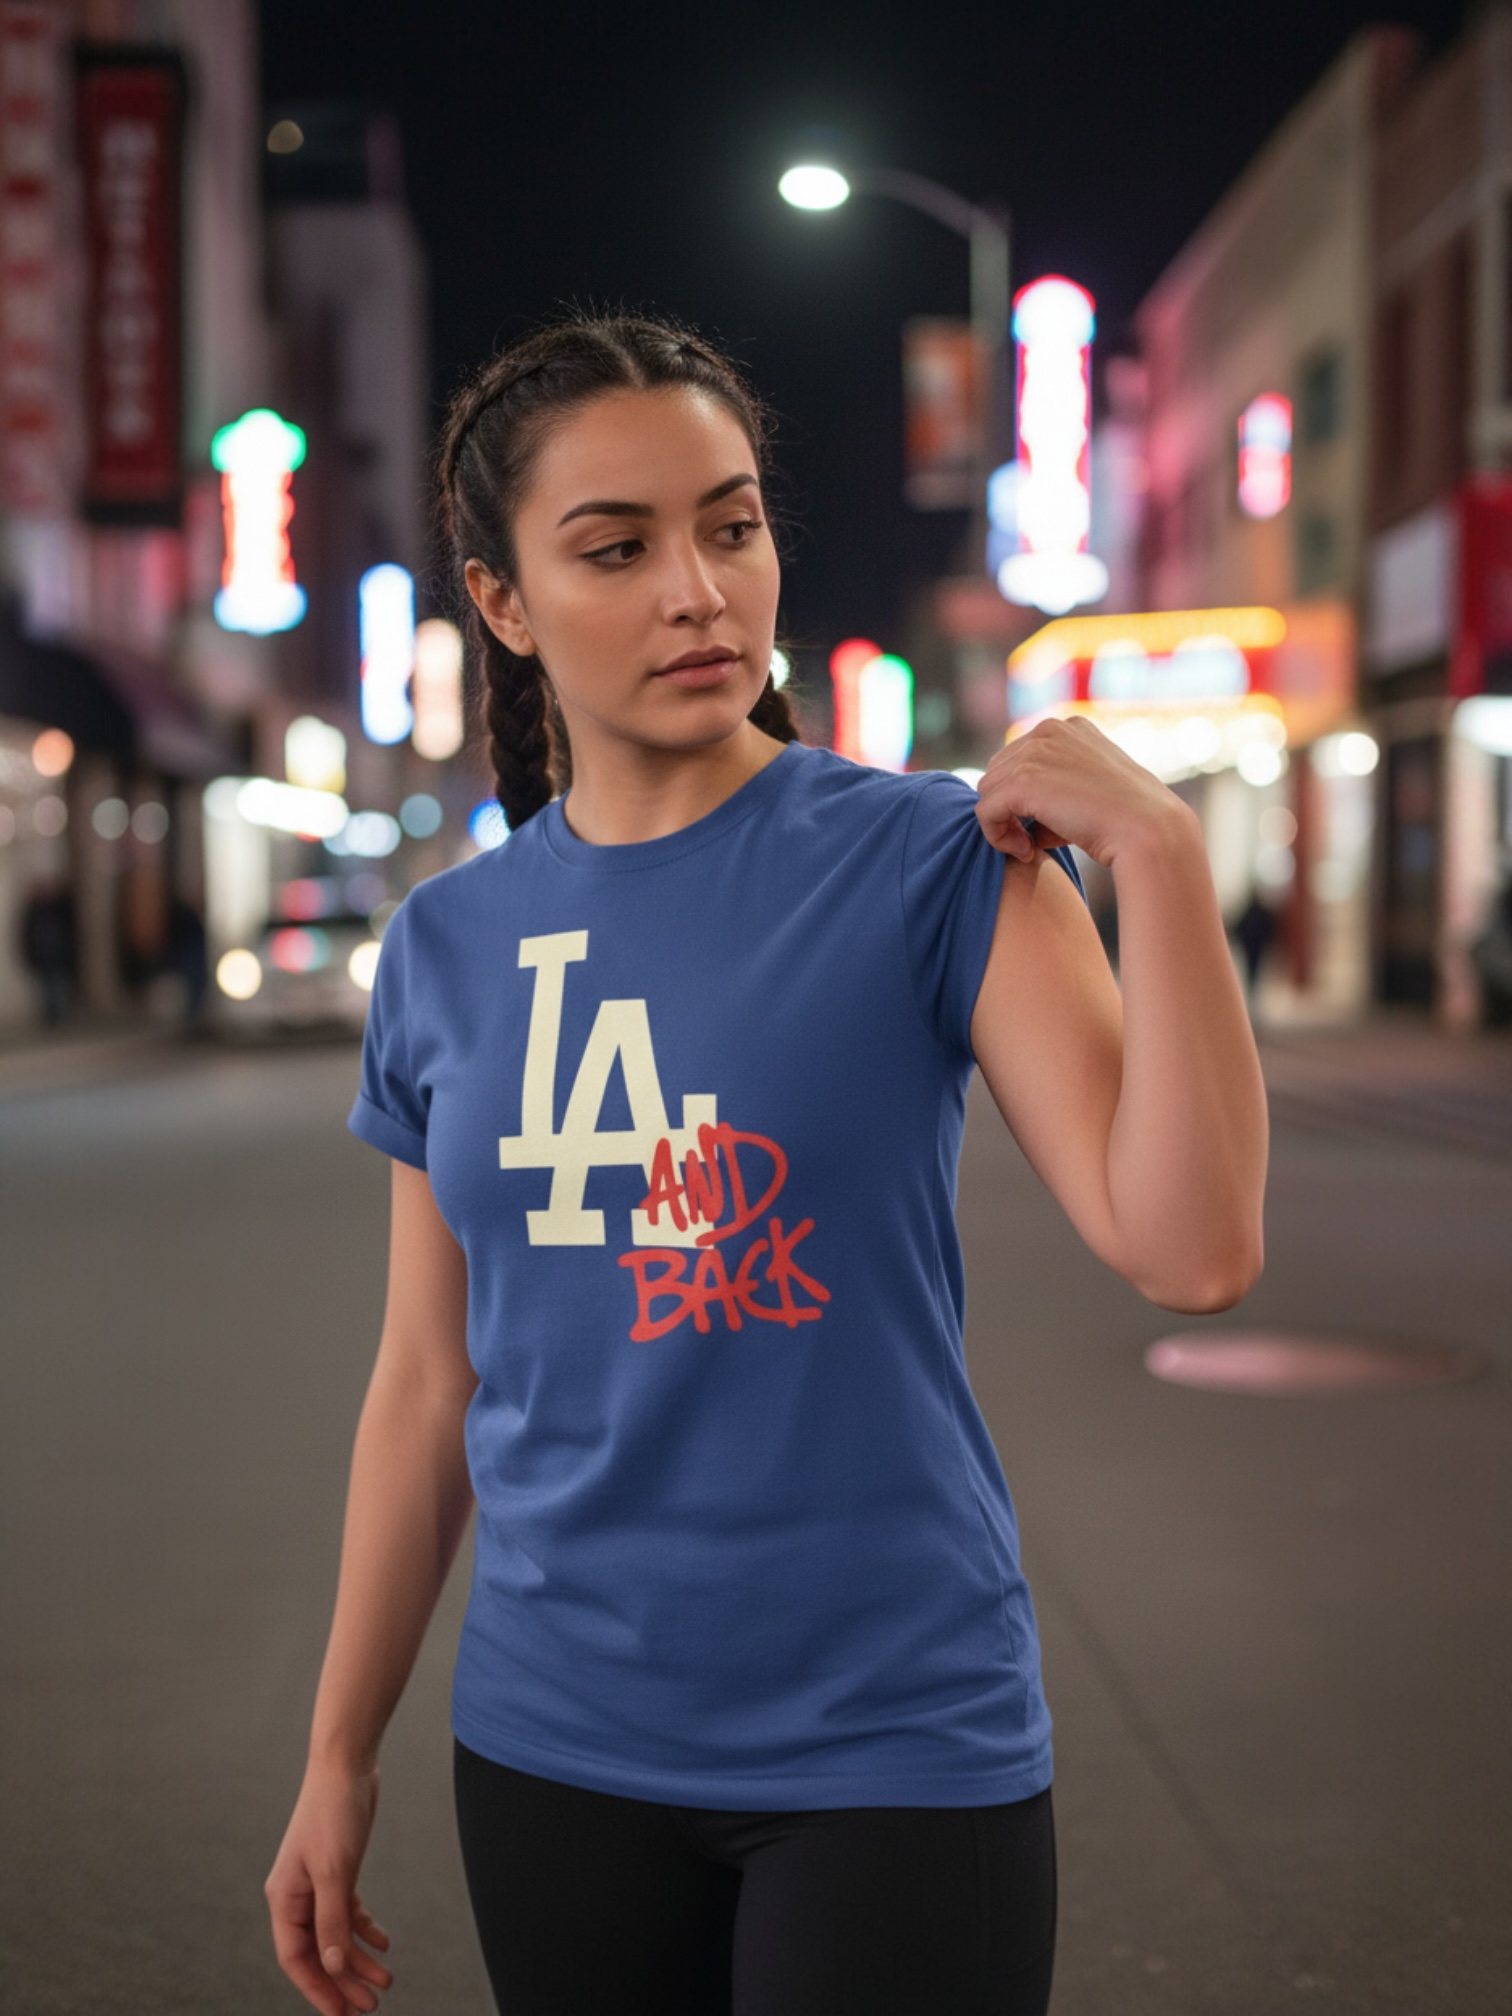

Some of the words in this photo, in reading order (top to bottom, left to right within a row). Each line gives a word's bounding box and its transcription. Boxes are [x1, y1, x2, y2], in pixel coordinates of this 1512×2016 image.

[499, 930, 717, 1249] LA
[639, 1122, 788, 1248] AND
[618, 1217, 831, 1343] BACK
